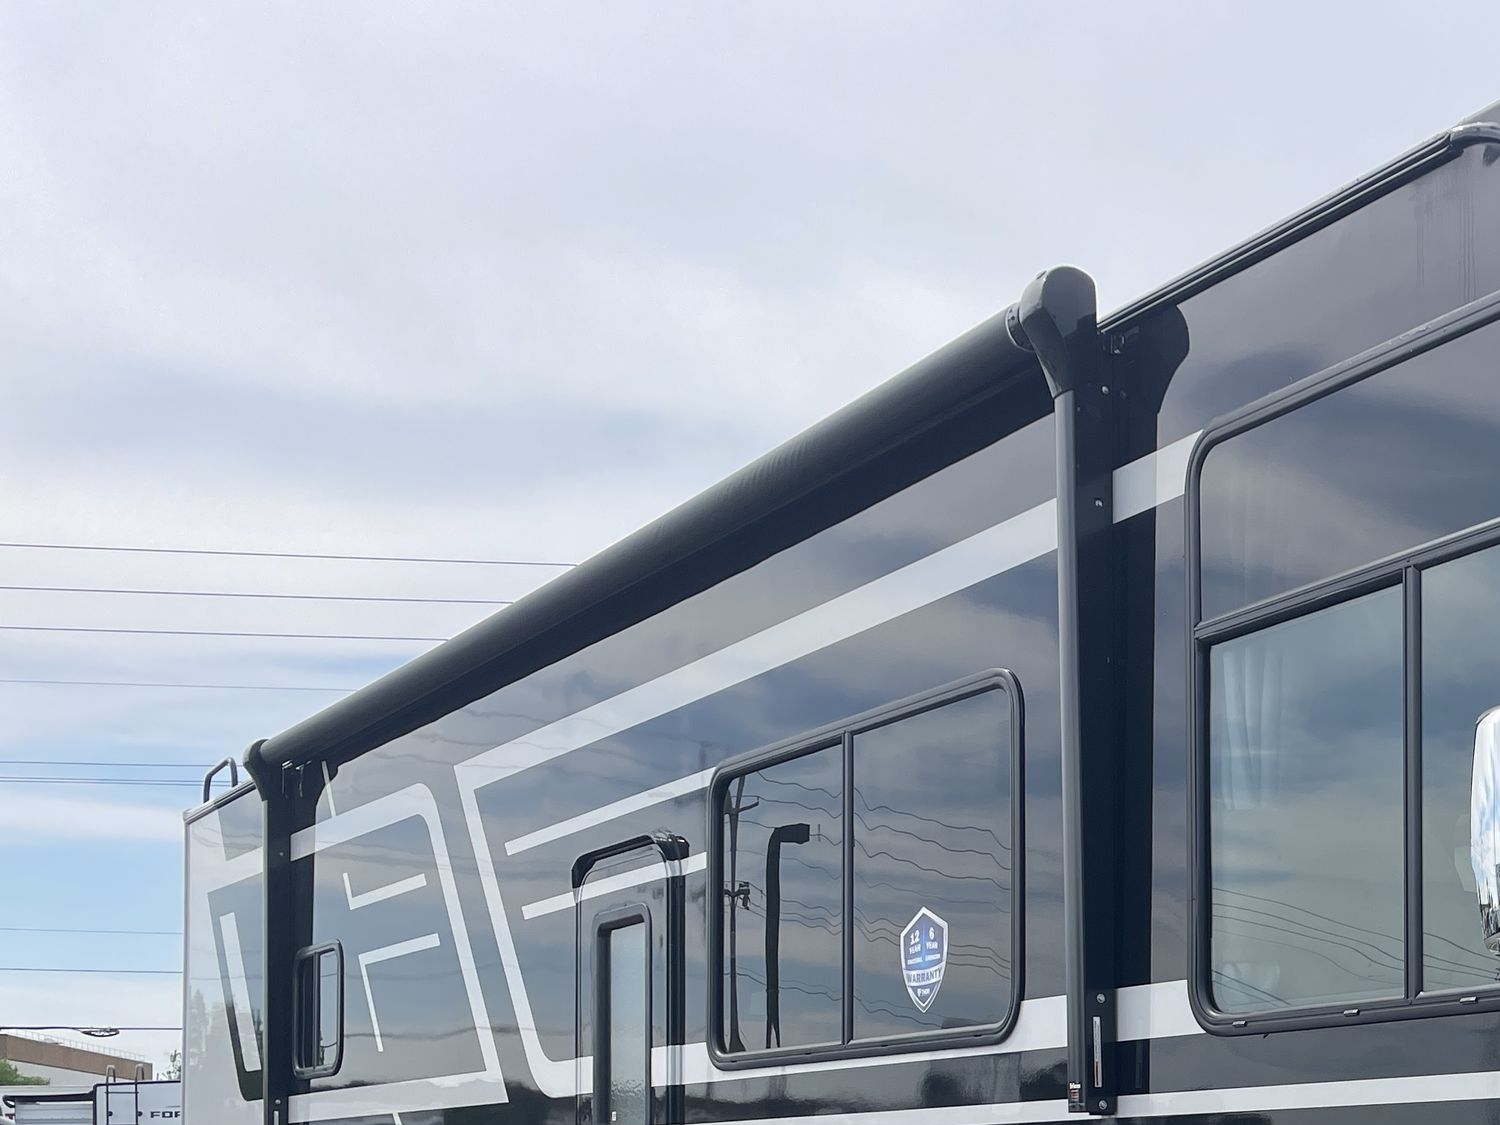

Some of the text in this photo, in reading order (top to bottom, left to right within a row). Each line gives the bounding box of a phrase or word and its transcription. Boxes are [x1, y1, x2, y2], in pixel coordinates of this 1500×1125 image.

[910, 929, 920, 945] 12
[929, 927, 935, 940] 6
[909, 943, 921, 955] YEAR
[926, 941, 938, 950] YEAR
[906, 967, 942, 984] WARRANTY
